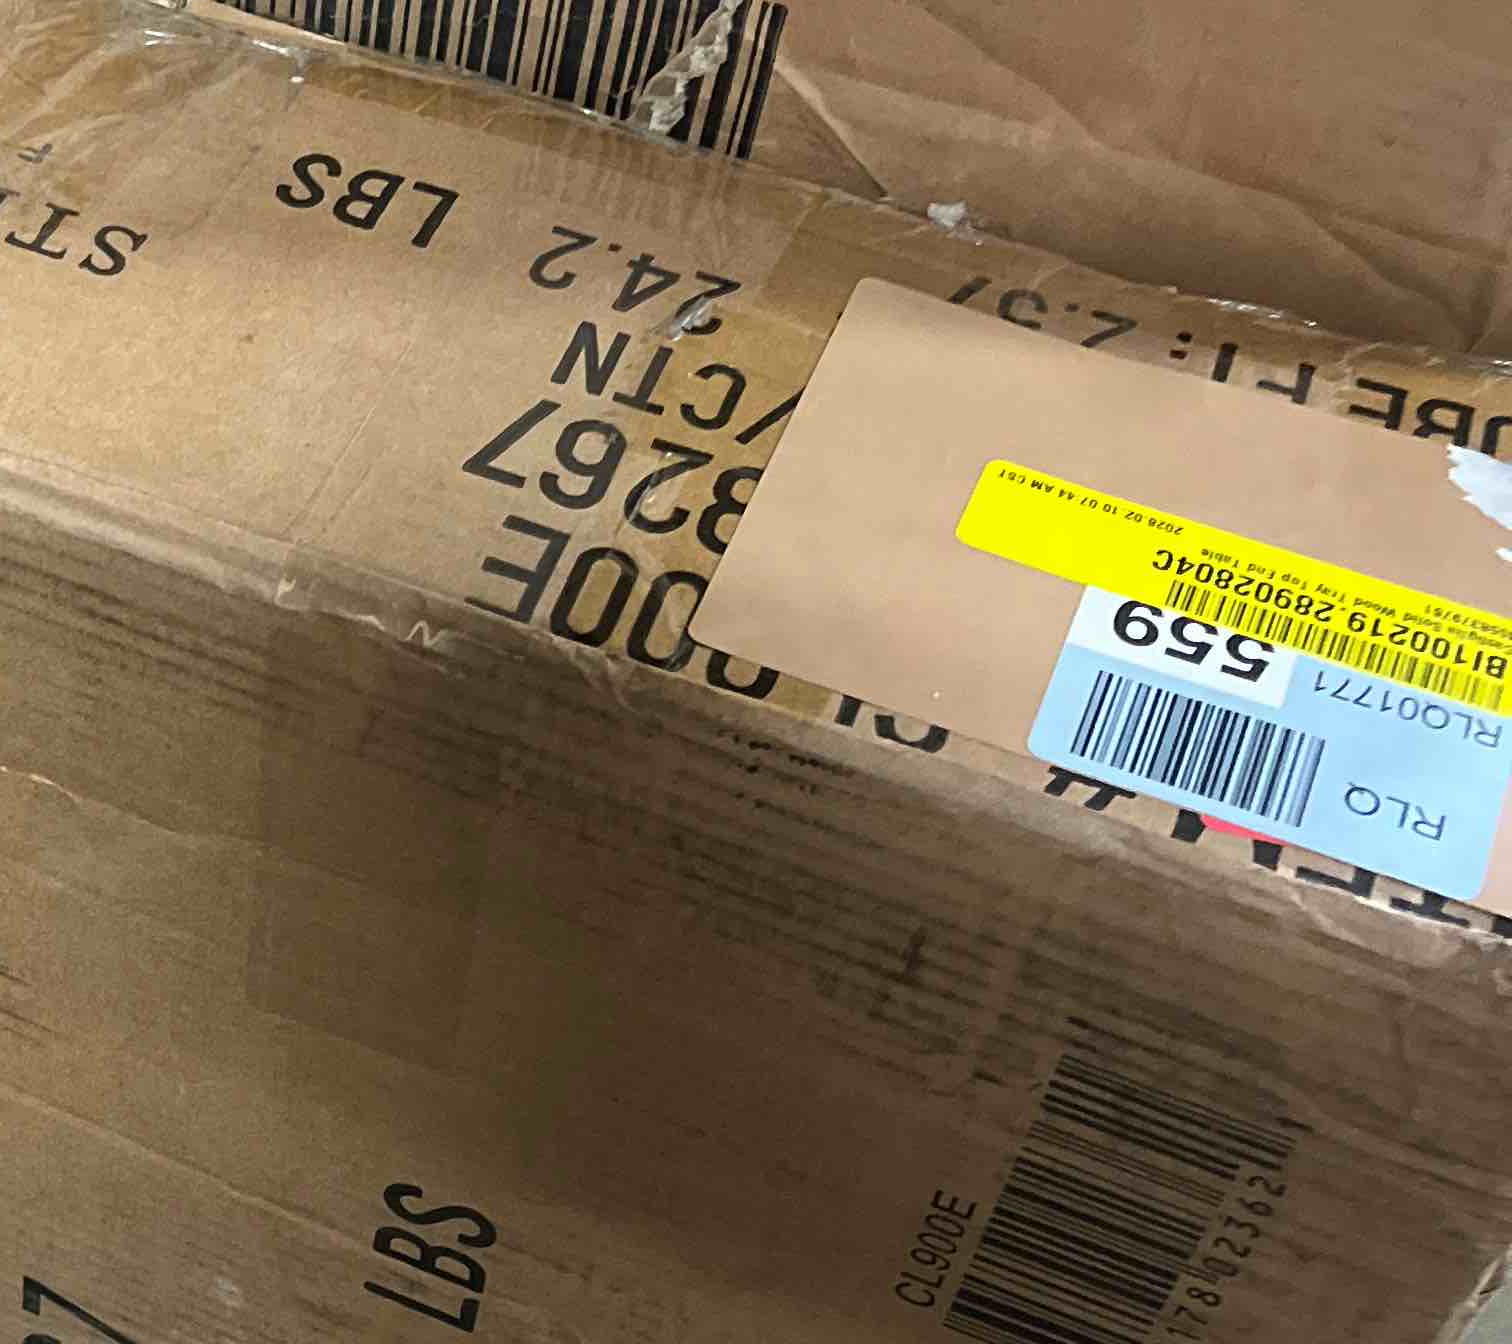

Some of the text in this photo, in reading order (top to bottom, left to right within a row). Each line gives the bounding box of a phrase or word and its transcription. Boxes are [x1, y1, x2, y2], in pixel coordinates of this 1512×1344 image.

[275, 152, 461, 249] LBS
[528, 224, 743, 338] 24.2
[1112, 598, 1277, 683] 559
[1312, 670, 1503, 750] RLQ01771
[1344, 781, 1447, 842] RLQ
[364, 1183, 499, 1333] LBS
[895, 1189, 978, 1308] CL900E
